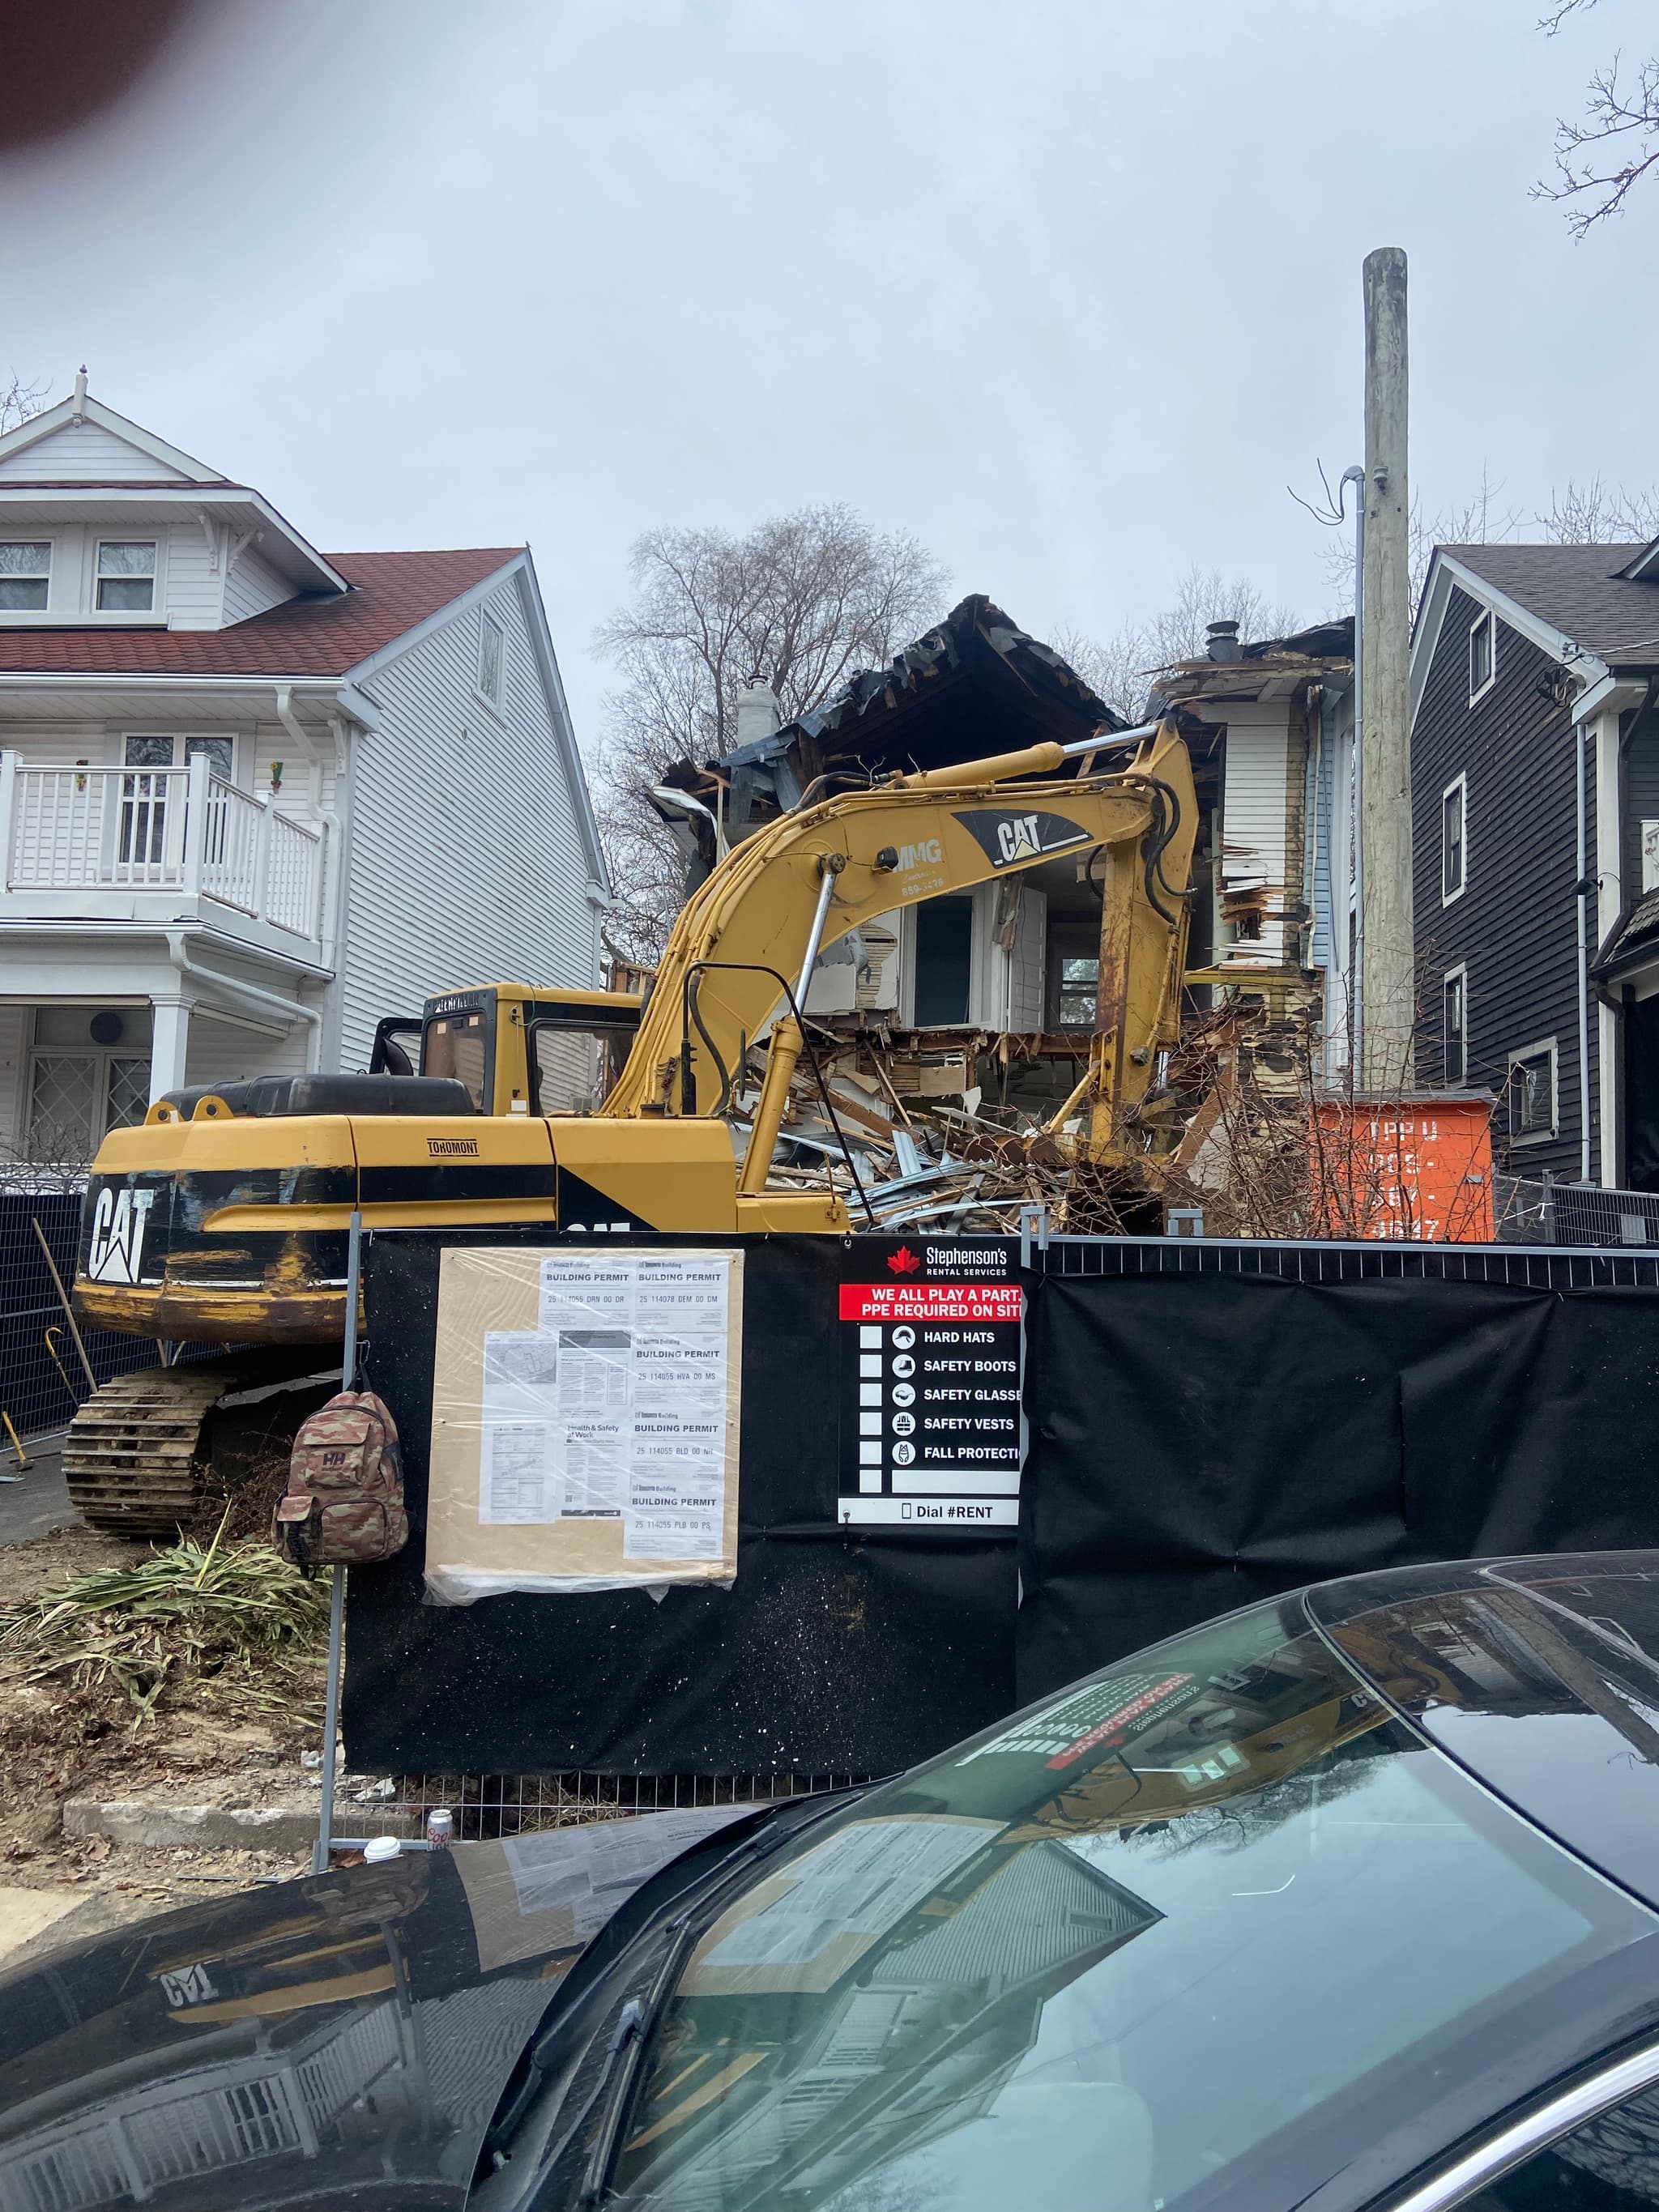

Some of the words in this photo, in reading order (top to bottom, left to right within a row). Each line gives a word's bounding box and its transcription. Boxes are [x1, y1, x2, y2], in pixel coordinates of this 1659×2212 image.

[997, 815, 1042, 861] CAT
[427, 1141, 478, 1153] TOROMONT
[89, 1187, 155, 1283] CAT
[926, 1247, 1007, 1267] Stephenson's
[872, 1289, 895, 1301] WE
[898, 1289, 925, 1301] ALL
[928, 1289, 965, 1301] PLAY
[967, 1289, 978, 1301] A
[862, 1304, 889, 1316] PPE
[893, 1304, 969, 1318] REQUIRED
[972, 1305, 992, 1317] ON
[924, 1332, 960, 1343] HARD
[963, 1332, 995, 1343] HATS
[923, 1360, 972, 1371] SAFETY
[975, 1361, 1017, 1372] BOOTS
[705, 1372, 715, 1380] MS
[923, 1389, 972, 1400] SAFETY
[923, 1418, 972, 1430] SAFETY
[975, 1418, 1014, 1430] VESTS
[649, 1447, 672, 1455] 114055
[676, 1447, 689, 1455] BLD
[924, 1447, 955, 1459] FALL
[957, 1447, 1020, 1459] PROTECTI
[323, 1451, 346, 1465] HH
[632, 1498, 678, 1506] BUILDING
[680, 1498, 717, 1507] PERMIT
[917, 1506, 943, 1518] Dial
[947, 1507, 993, 1518] #RENT
[674, 1521, 686, 1529] PLB
